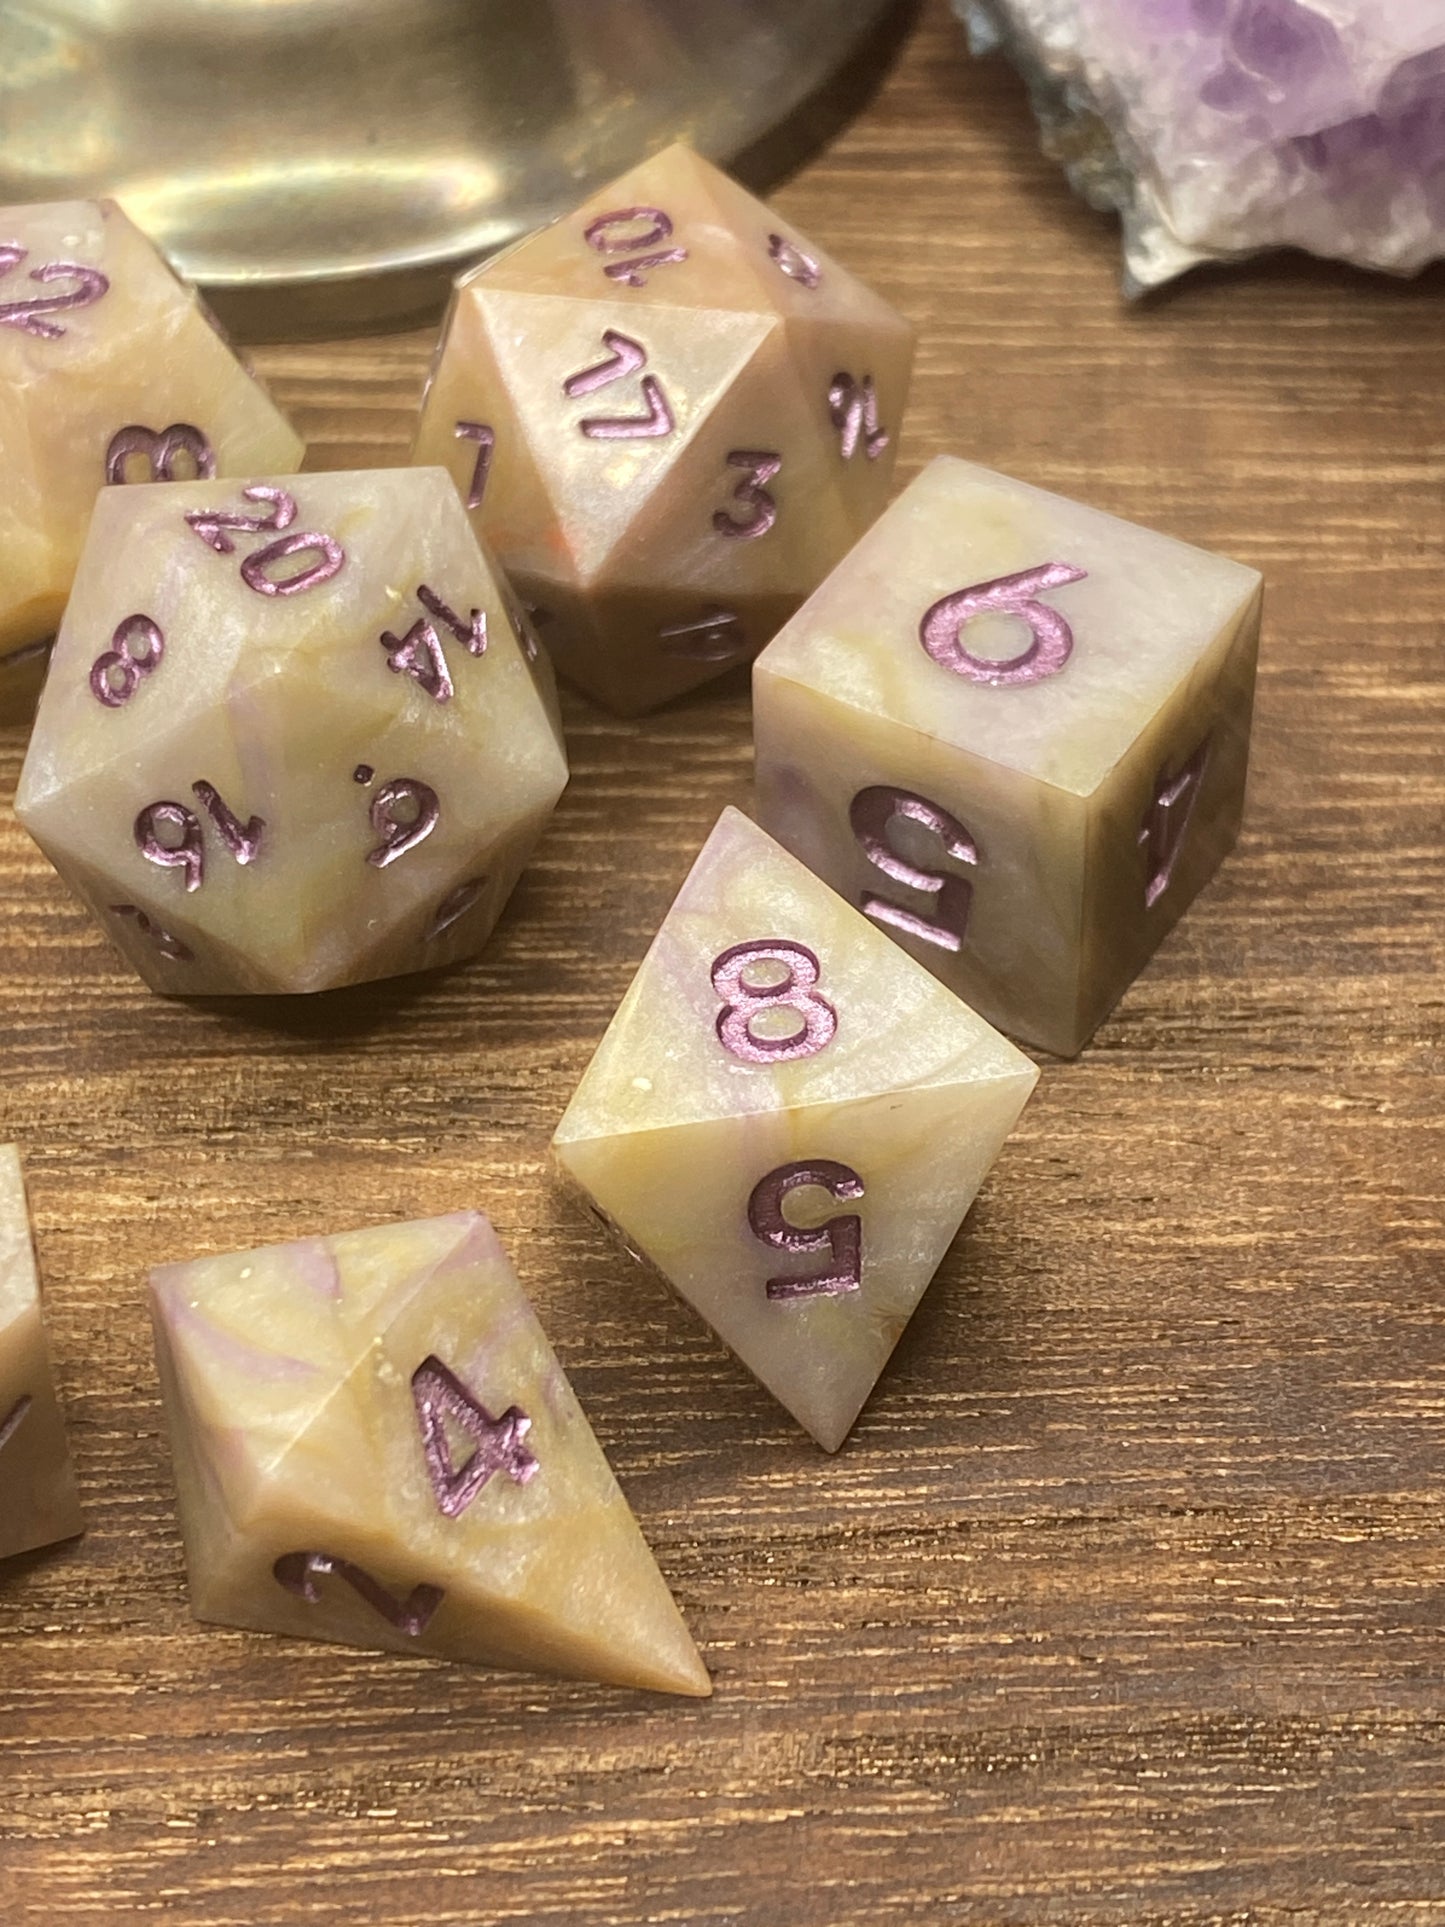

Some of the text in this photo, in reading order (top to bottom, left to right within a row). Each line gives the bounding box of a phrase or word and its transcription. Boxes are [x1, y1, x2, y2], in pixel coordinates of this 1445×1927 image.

[0, 241, 109, 340] 2
[584, 206, 682, 287] 10
[564, 328, 676, 440] 17
[454, 420, 495, 510] 7
[712, 450, 783, 540] 3
[184, 485, 344, 595] 20
[90, 613, 165, 708] 8
[379, 584, 488, 705] 14
[919, 560, 1088, 686] 6
[134, 779, 267, 893] 16
[848, 784, 981, 952] 5
[711, 939, 839, 1064] 8
[747, 1159, 866, 1300] 5
[410, 1354, 541, 1519] 4
[272, 1550, 447, 1637] 2
